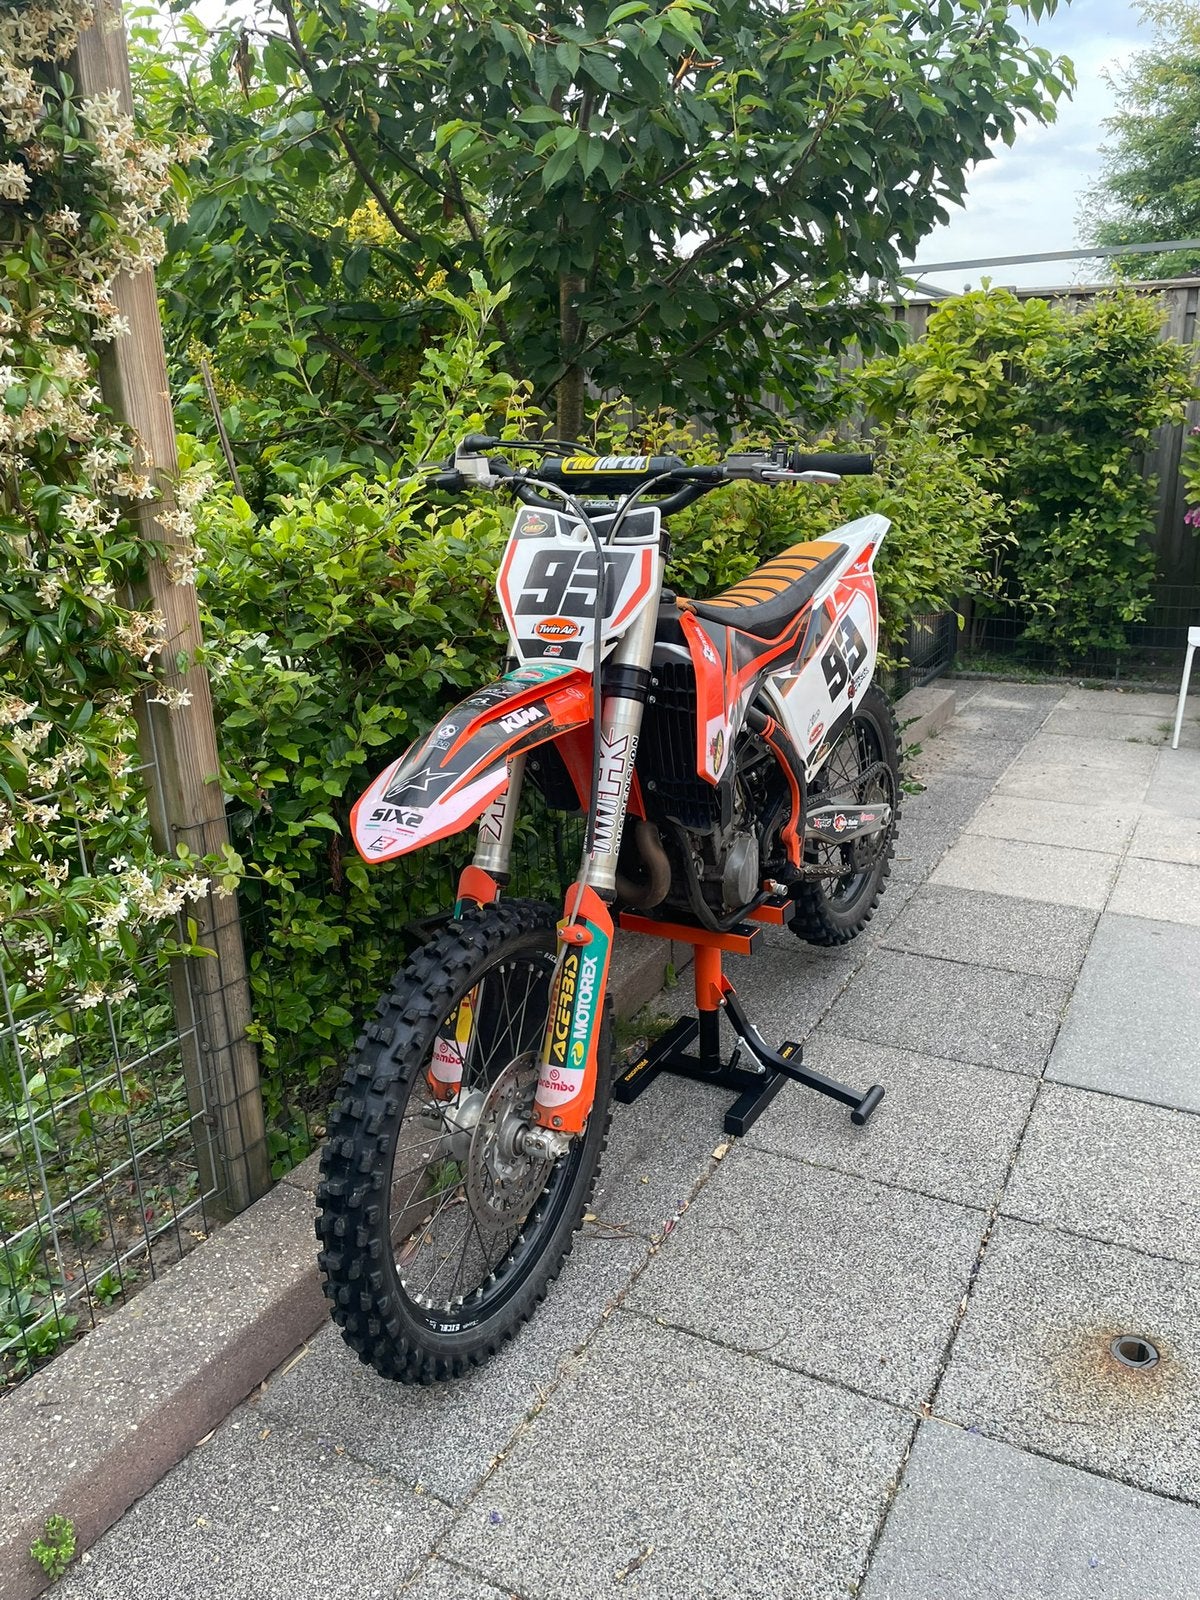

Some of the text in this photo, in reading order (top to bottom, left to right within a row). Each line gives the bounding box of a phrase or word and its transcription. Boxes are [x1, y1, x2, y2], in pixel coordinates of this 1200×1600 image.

[514, 550, 635, 619] 93
[539, 624, 577, 635] Twin Air
[821, 614, 868, 703] 93
[499, 706, 545, 734] KTM
[369, 808, 424, 828] SIX2
[614, 735, 639, 856] SUSPENSION
[572, 956, 598, 1039] MOTOREX
[432, 1052, 462, 1065] rembo
